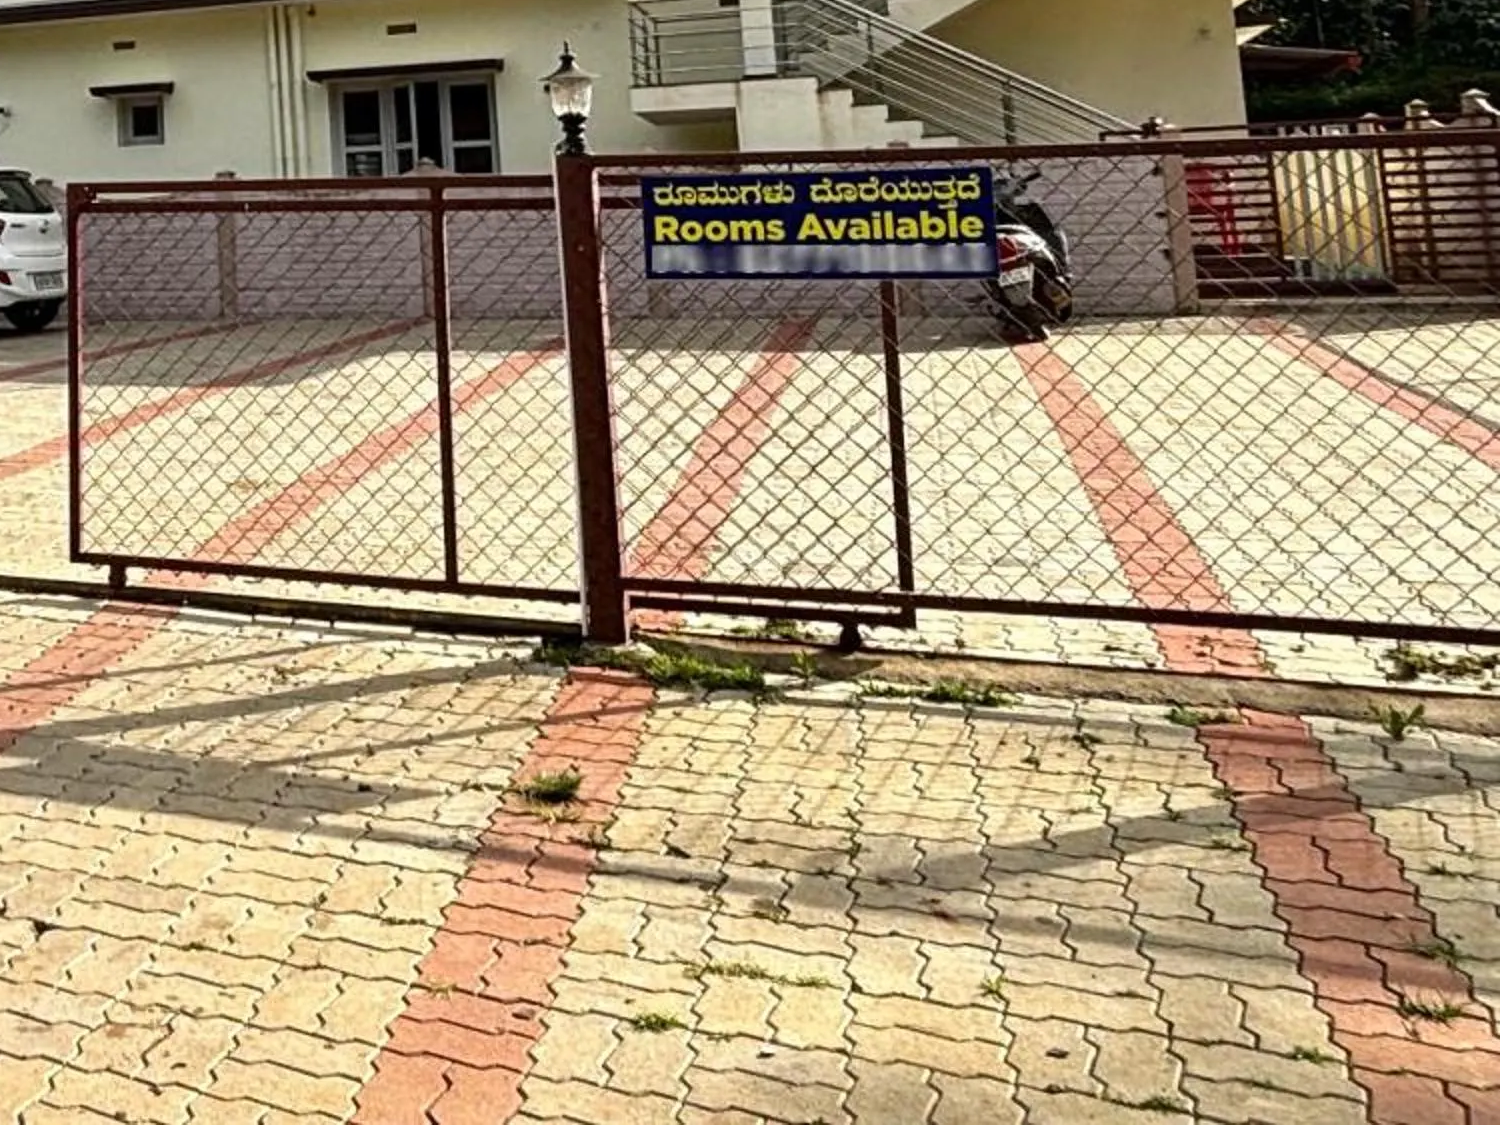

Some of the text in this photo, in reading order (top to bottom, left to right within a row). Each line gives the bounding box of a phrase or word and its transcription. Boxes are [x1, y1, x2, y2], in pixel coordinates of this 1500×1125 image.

[652, 173, 981, 210] ರೂಮುಗಳು ದೊರೆಯುತ್ತದೆ
[654, 210, 984, 242] Rooms Available
